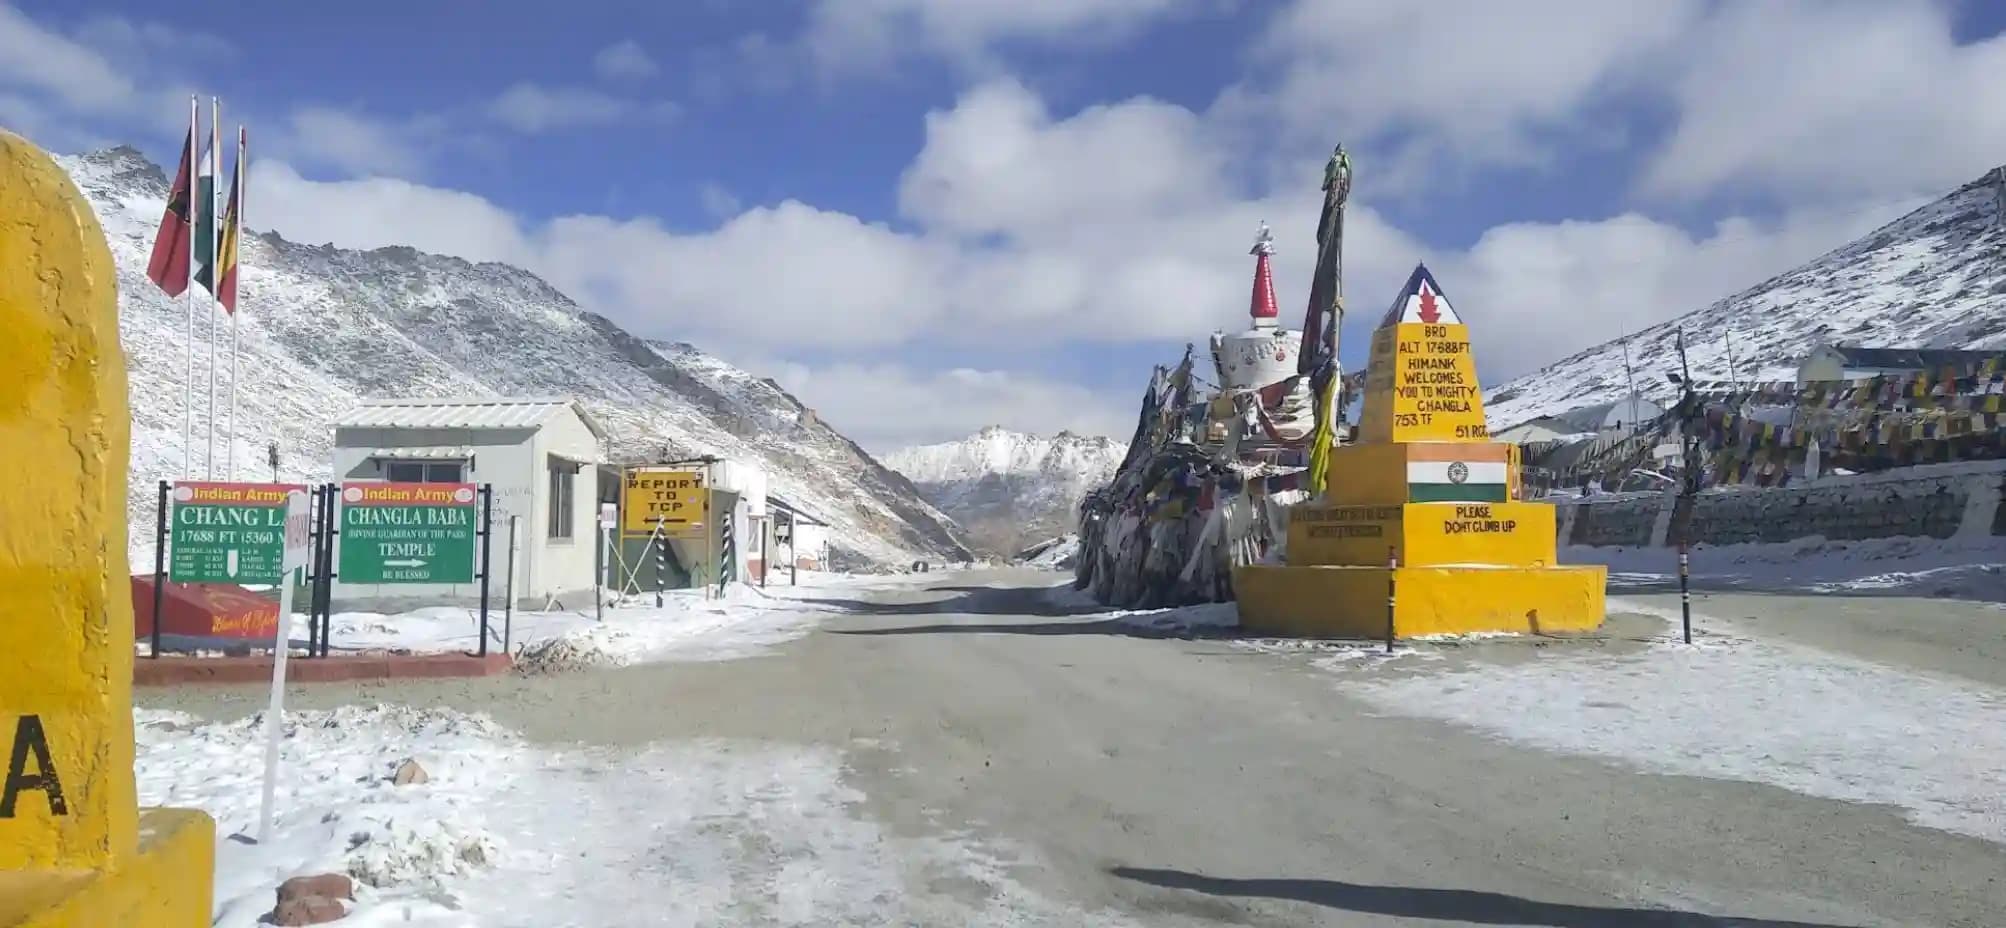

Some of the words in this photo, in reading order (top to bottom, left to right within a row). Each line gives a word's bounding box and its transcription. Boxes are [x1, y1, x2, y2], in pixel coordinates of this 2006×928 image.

[1424, 326, 1447, 338] BRO
[1399, 342, 1420, 354] ALT
[1408, 358, 1456, 370] HIMANK
[1404, 373, 1463, 384] WELCOMES
[1396, 387, 1418, 398] YOU
[1421, 387, 1433, 397] TO
[1436, 387, 1477, 398] MIGHTY
[1417, 401, 1472, 413] CHANGLA
[1395, 414, 1418, 426] 753
[1421, 414, 1432, 425] TF
[1455, 425, 1469, 438] 51
[628, 480, 702, 489] REPORT
[194, 487, 241, 500] Indian
[245, 488, 286, 503] Army
[364, 488, 410, 500] Indian
[414, 488, 454, 503] Army
[653, 491, 677, 500] TO
[648, 503, 682, 512] TCP
[1456, 506, 1492, 518] PLEASE
[180, 507, 259, 525] CHANG
[267, 508, 285, 527] L
[348, 507, 422, 525] CHANGLA
[427, 508, 467, 525] BABA
[1473, 521, 1500, 532] CLIMB
[1502, 521, 1516, 532] UP
[180, 531, 215, 543] 17688
[219, 531, 237, 544] FT
[378, 543, 436, 556] TEMPLE
[382, 571, 393, 579] BE
[395, 571, 430, 579] BLESSED
[0, 713, 68, 818] A
